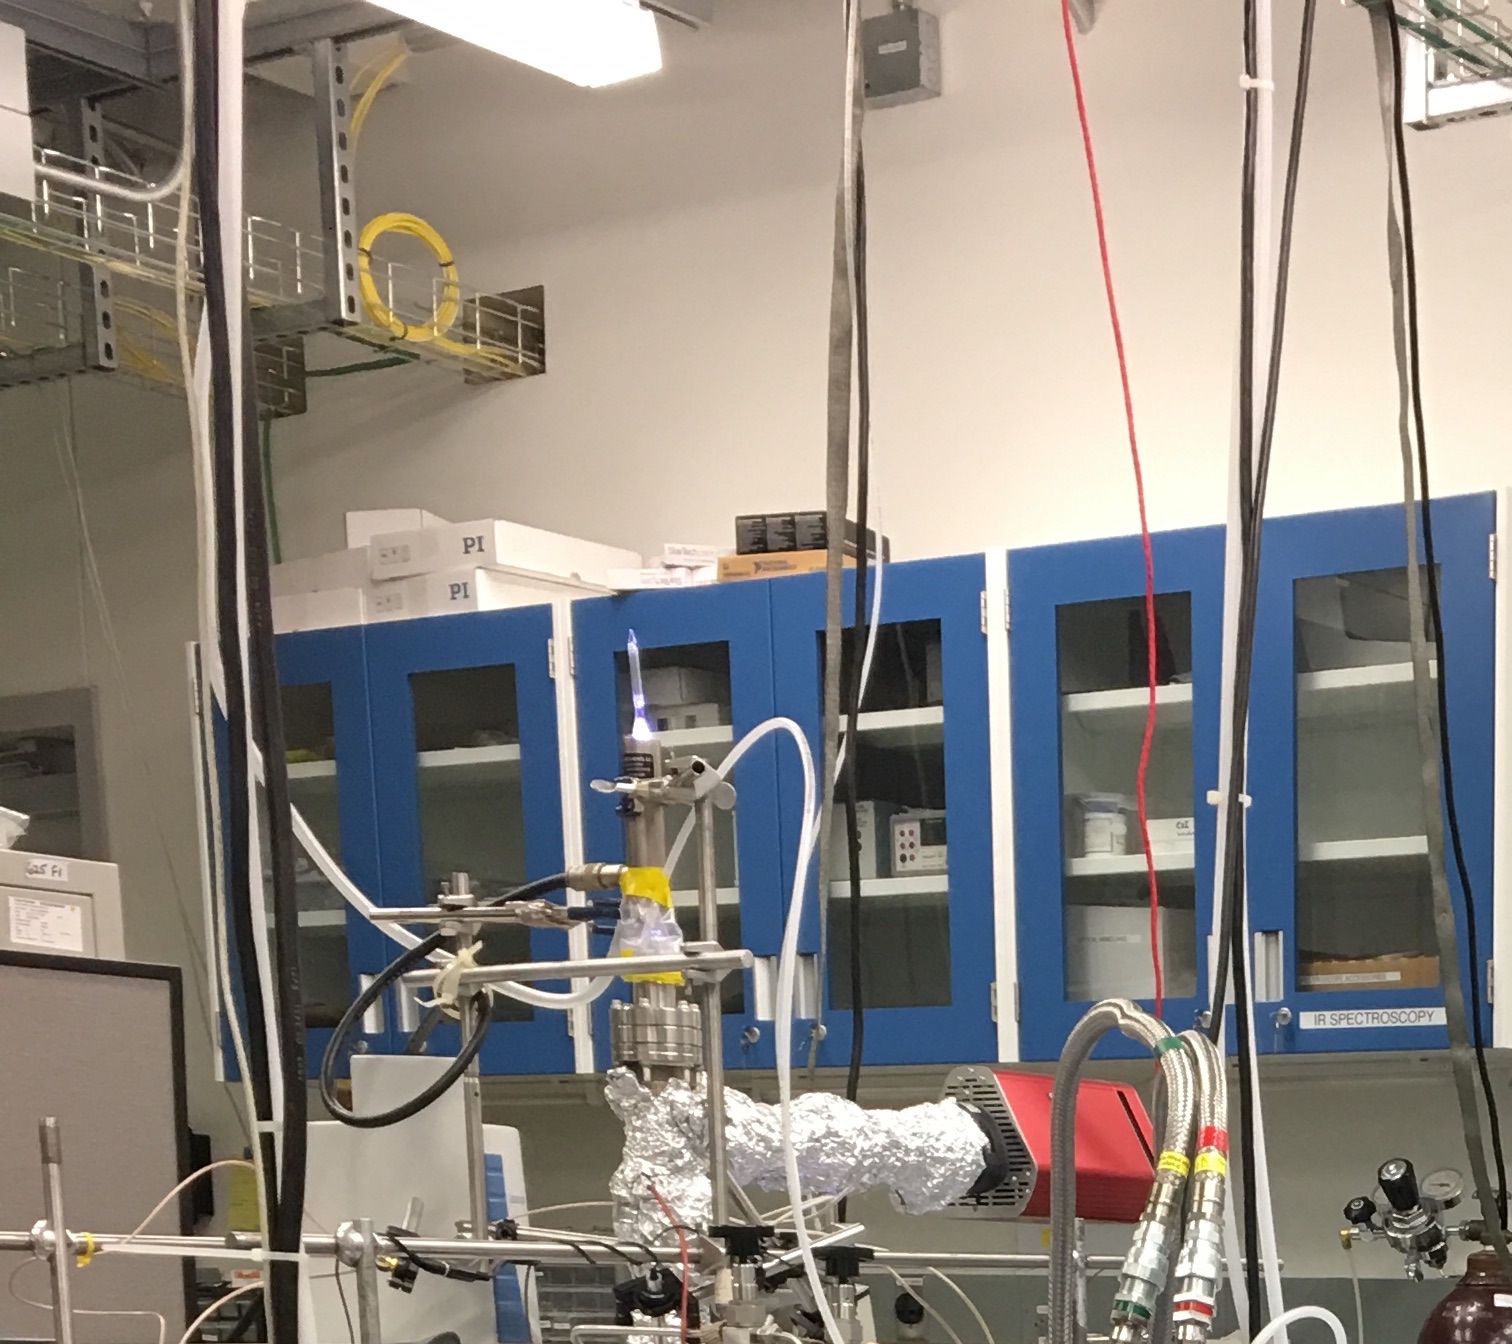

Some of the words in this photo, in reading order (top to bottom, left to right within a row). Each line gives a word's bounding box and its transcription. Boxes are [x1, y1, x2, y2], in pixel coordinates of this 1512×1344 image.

[462, 535, 485, 554] PI
[449, 582, 470, 600] PI
[1314, 1013, 1326, 1026] IR
[1329, 1010, 1435, 1026] SPECTROSCOPY
